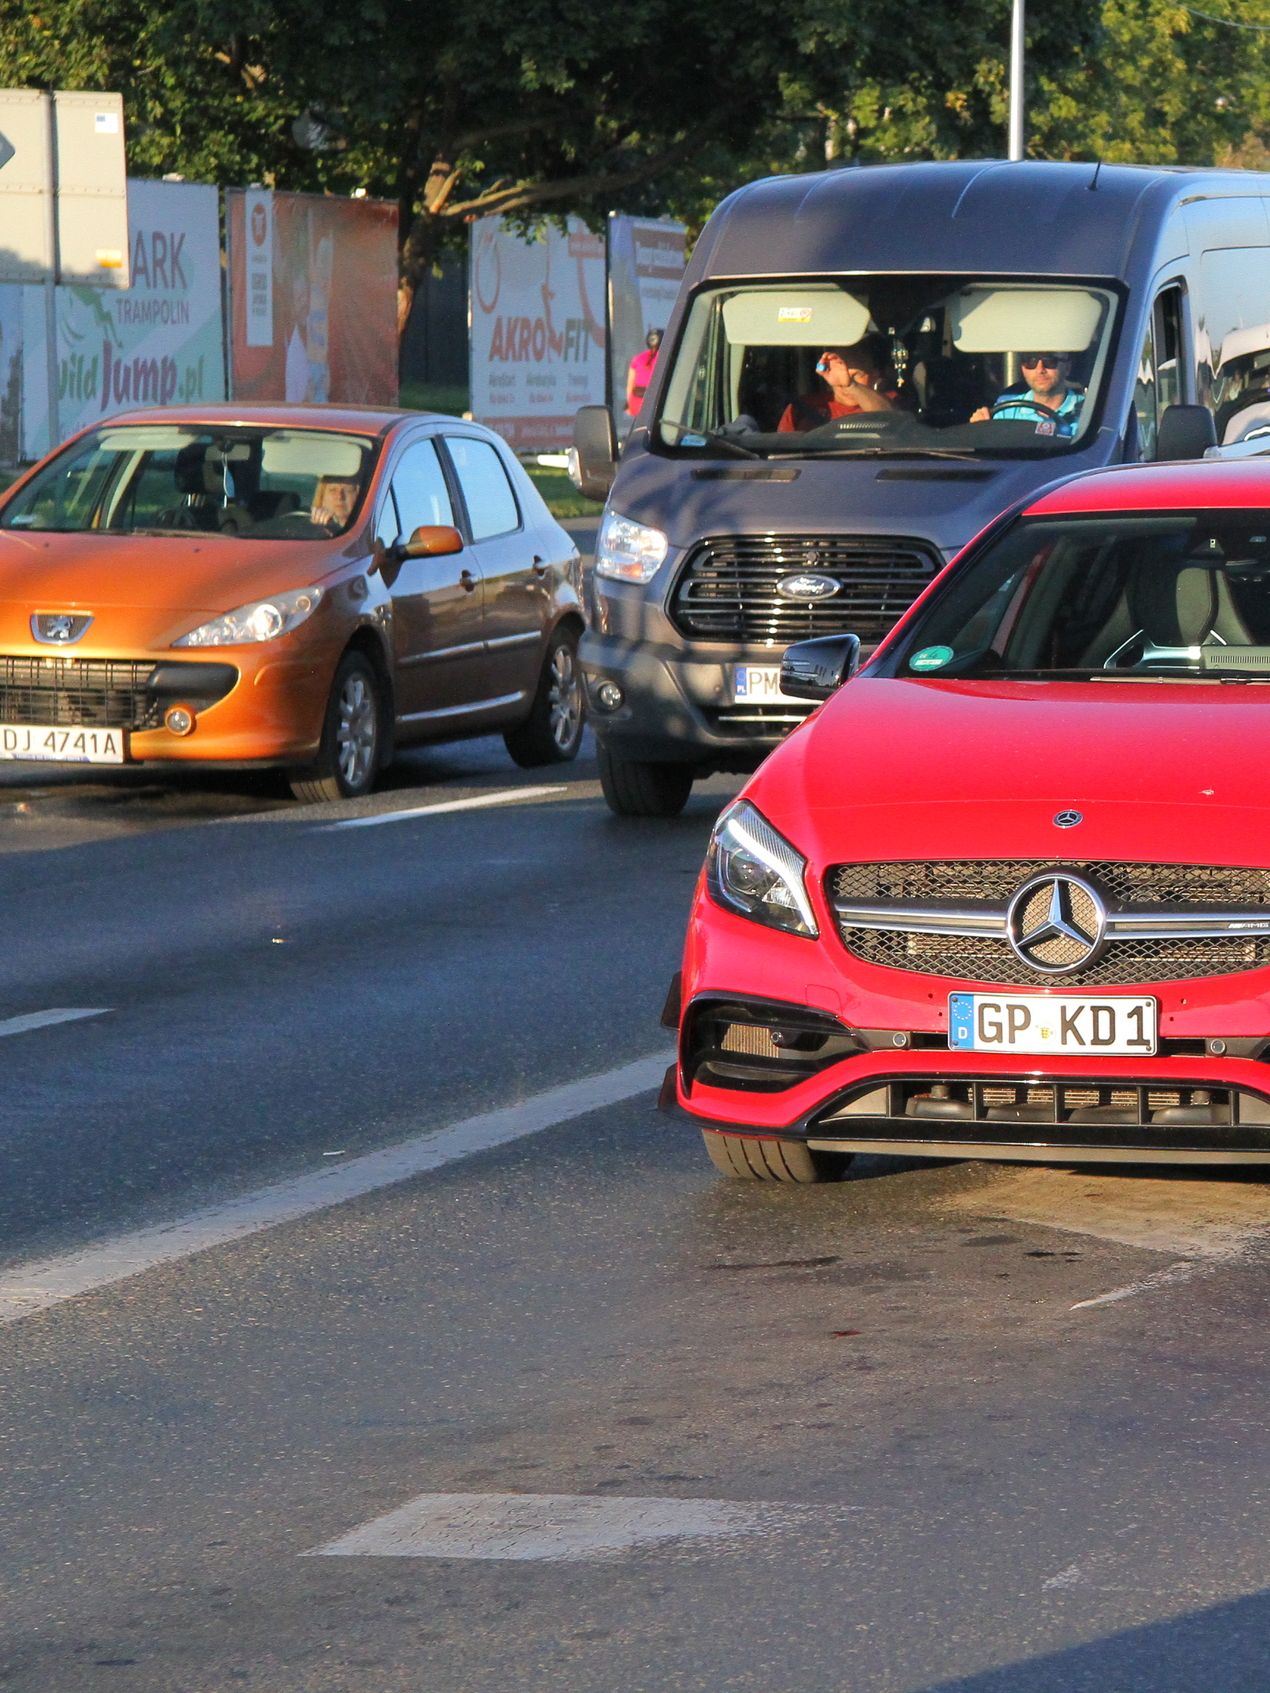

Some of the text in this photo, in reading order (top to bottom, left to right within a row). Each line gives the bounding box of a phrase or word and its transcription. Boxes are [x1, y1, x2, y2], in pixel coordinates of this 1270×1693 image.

[115, 298, 190, 325] TRAMPOLIN
[748, 671, 779, 695] PM
[3, 728, 116, 754] DJ 4741A
[957, 1027, 968, 1039] D
[977, 1002, 1032, 1044] GP
